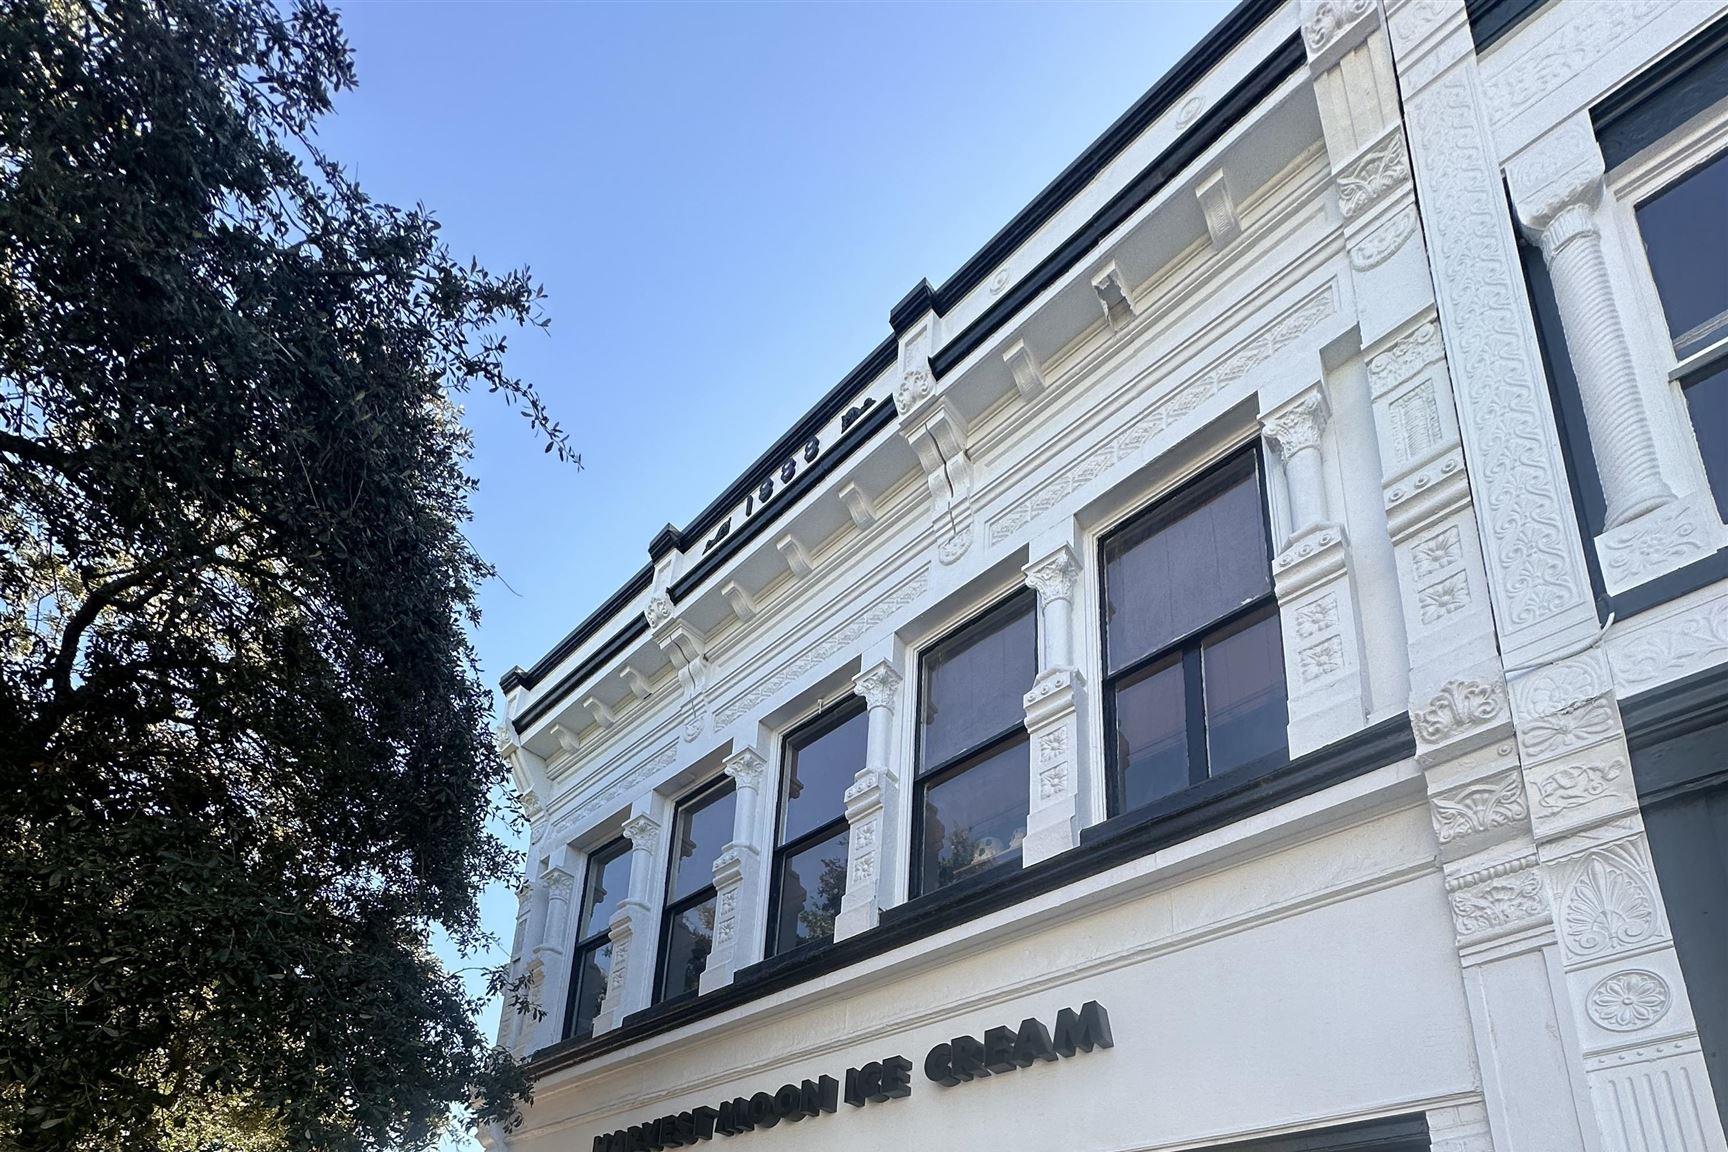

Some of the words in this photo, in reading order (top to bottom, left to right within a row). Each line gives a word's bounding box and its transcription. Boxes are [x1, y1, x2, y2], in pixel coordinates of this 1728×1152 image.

[745, 435, 820, 518] 1888
[714, 1073, 840, 1137] MOON
[844, 1054, 913, 1108] ICE
[923, 999, 1115, 1088] CREAM
